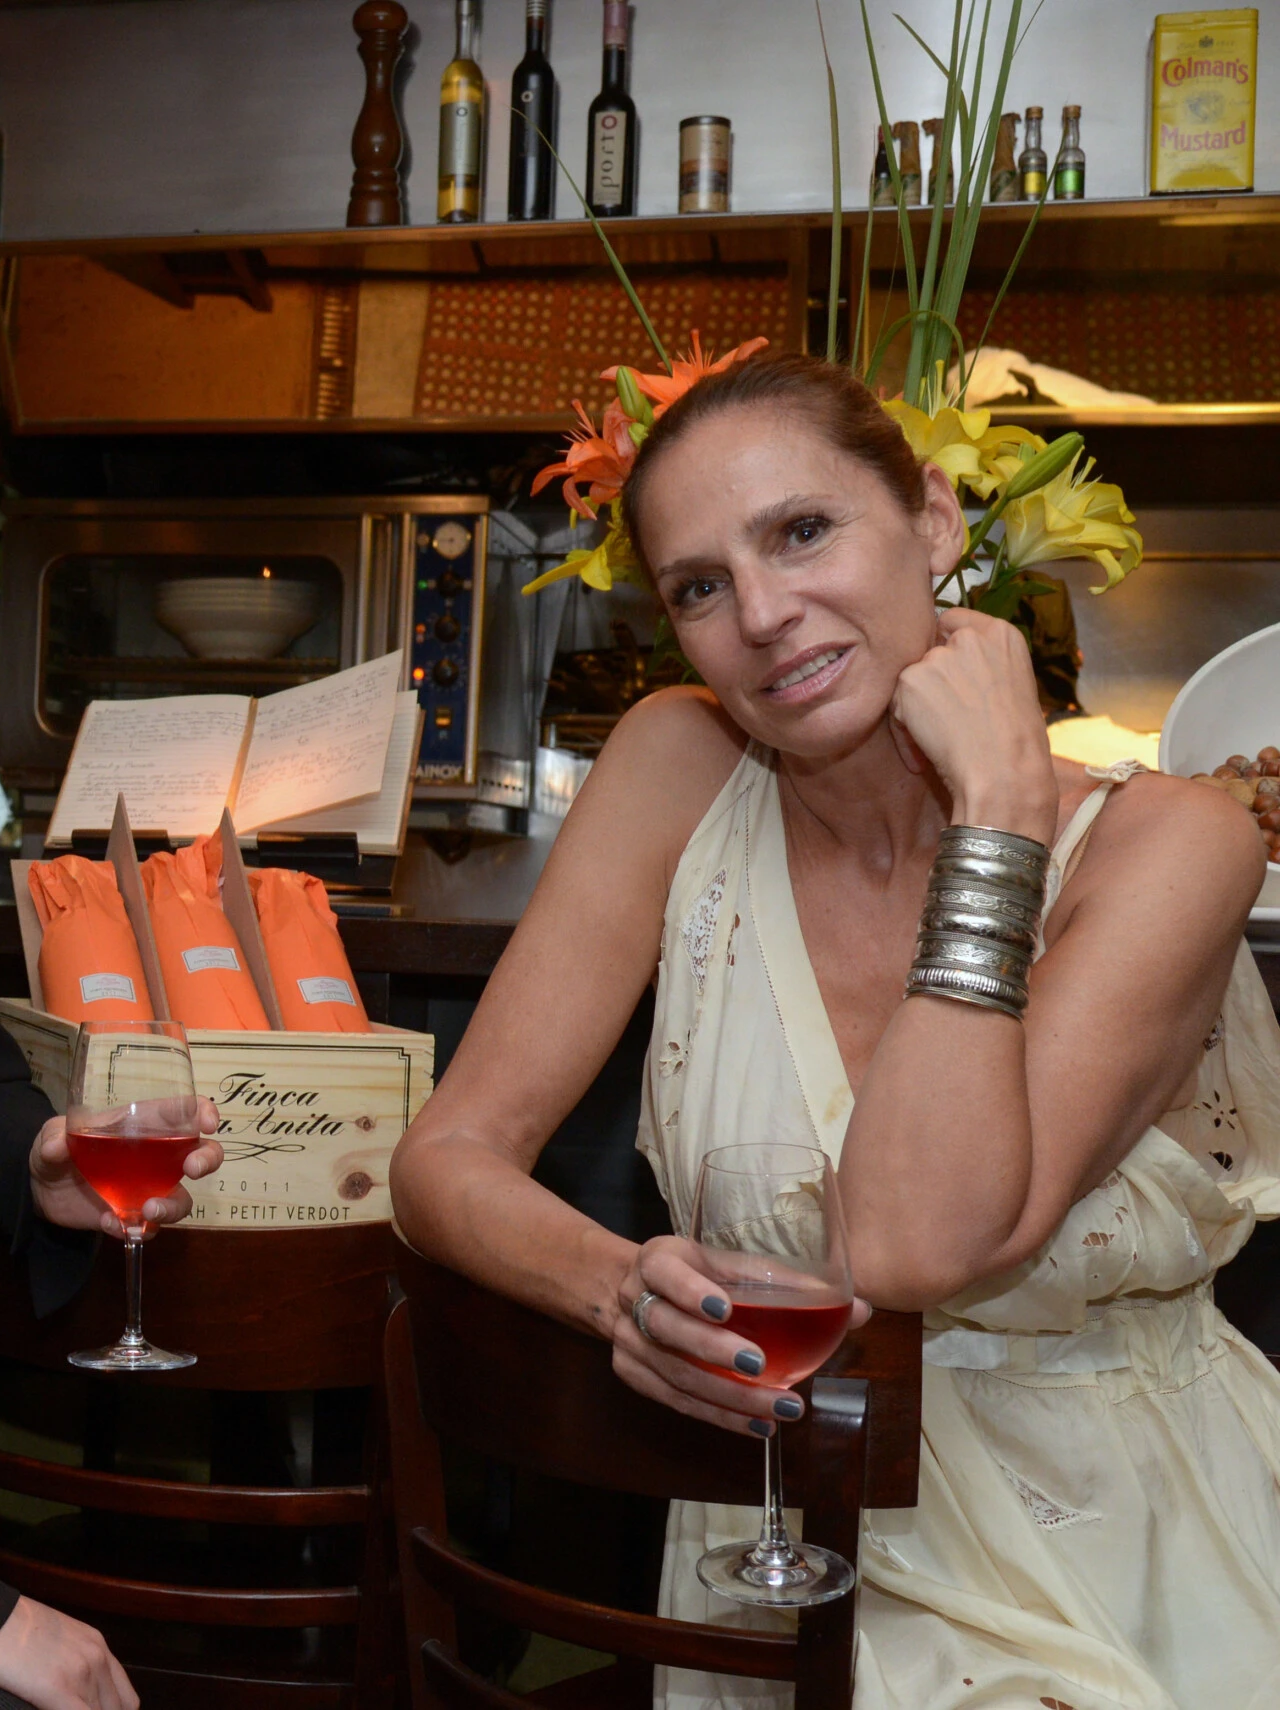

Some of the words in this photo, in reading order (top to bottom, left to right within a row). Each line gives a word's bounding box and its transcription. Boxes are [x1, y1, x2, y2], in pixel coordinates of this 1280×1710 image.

[1162, 57, 1248, 87] Colman's
[1161, 121, 1246, 151] Mustard
[210, 1072, 321, 1106] Finca
[232, 1107, 345, 1136] Anita
[219, 1180, 290, 1192] 2011
[230, 1205, 278, 1220] PETIT
[286, 1206, 352, 1221] VERDOT
